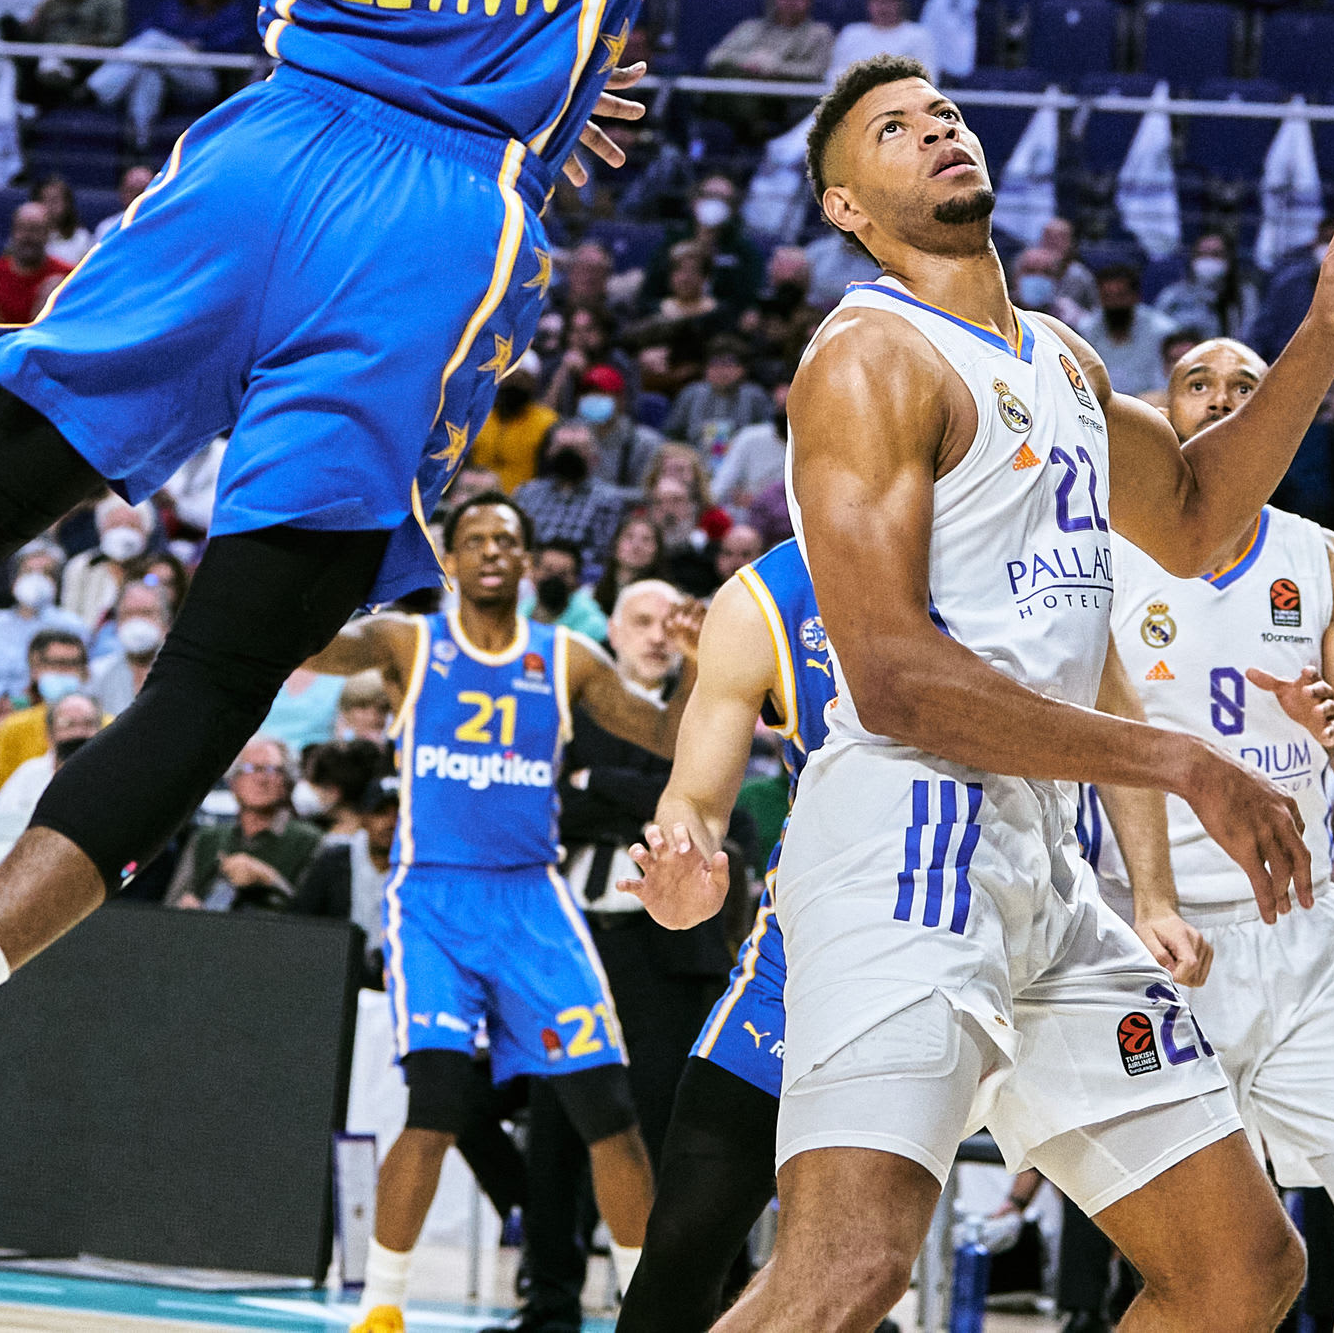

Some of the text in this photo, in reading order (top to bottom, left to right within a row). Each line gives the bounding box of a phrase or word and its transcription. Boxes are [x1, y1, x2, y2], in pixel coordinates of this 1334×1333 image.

[1049, 445, 1109, 534] 22
[1019, 594, 1100, 620] HOTEL
[455, 690, 517, 747] 21
[1210, 667, 1245, 736] 8
[415, 745, 553, 790] Playtika
